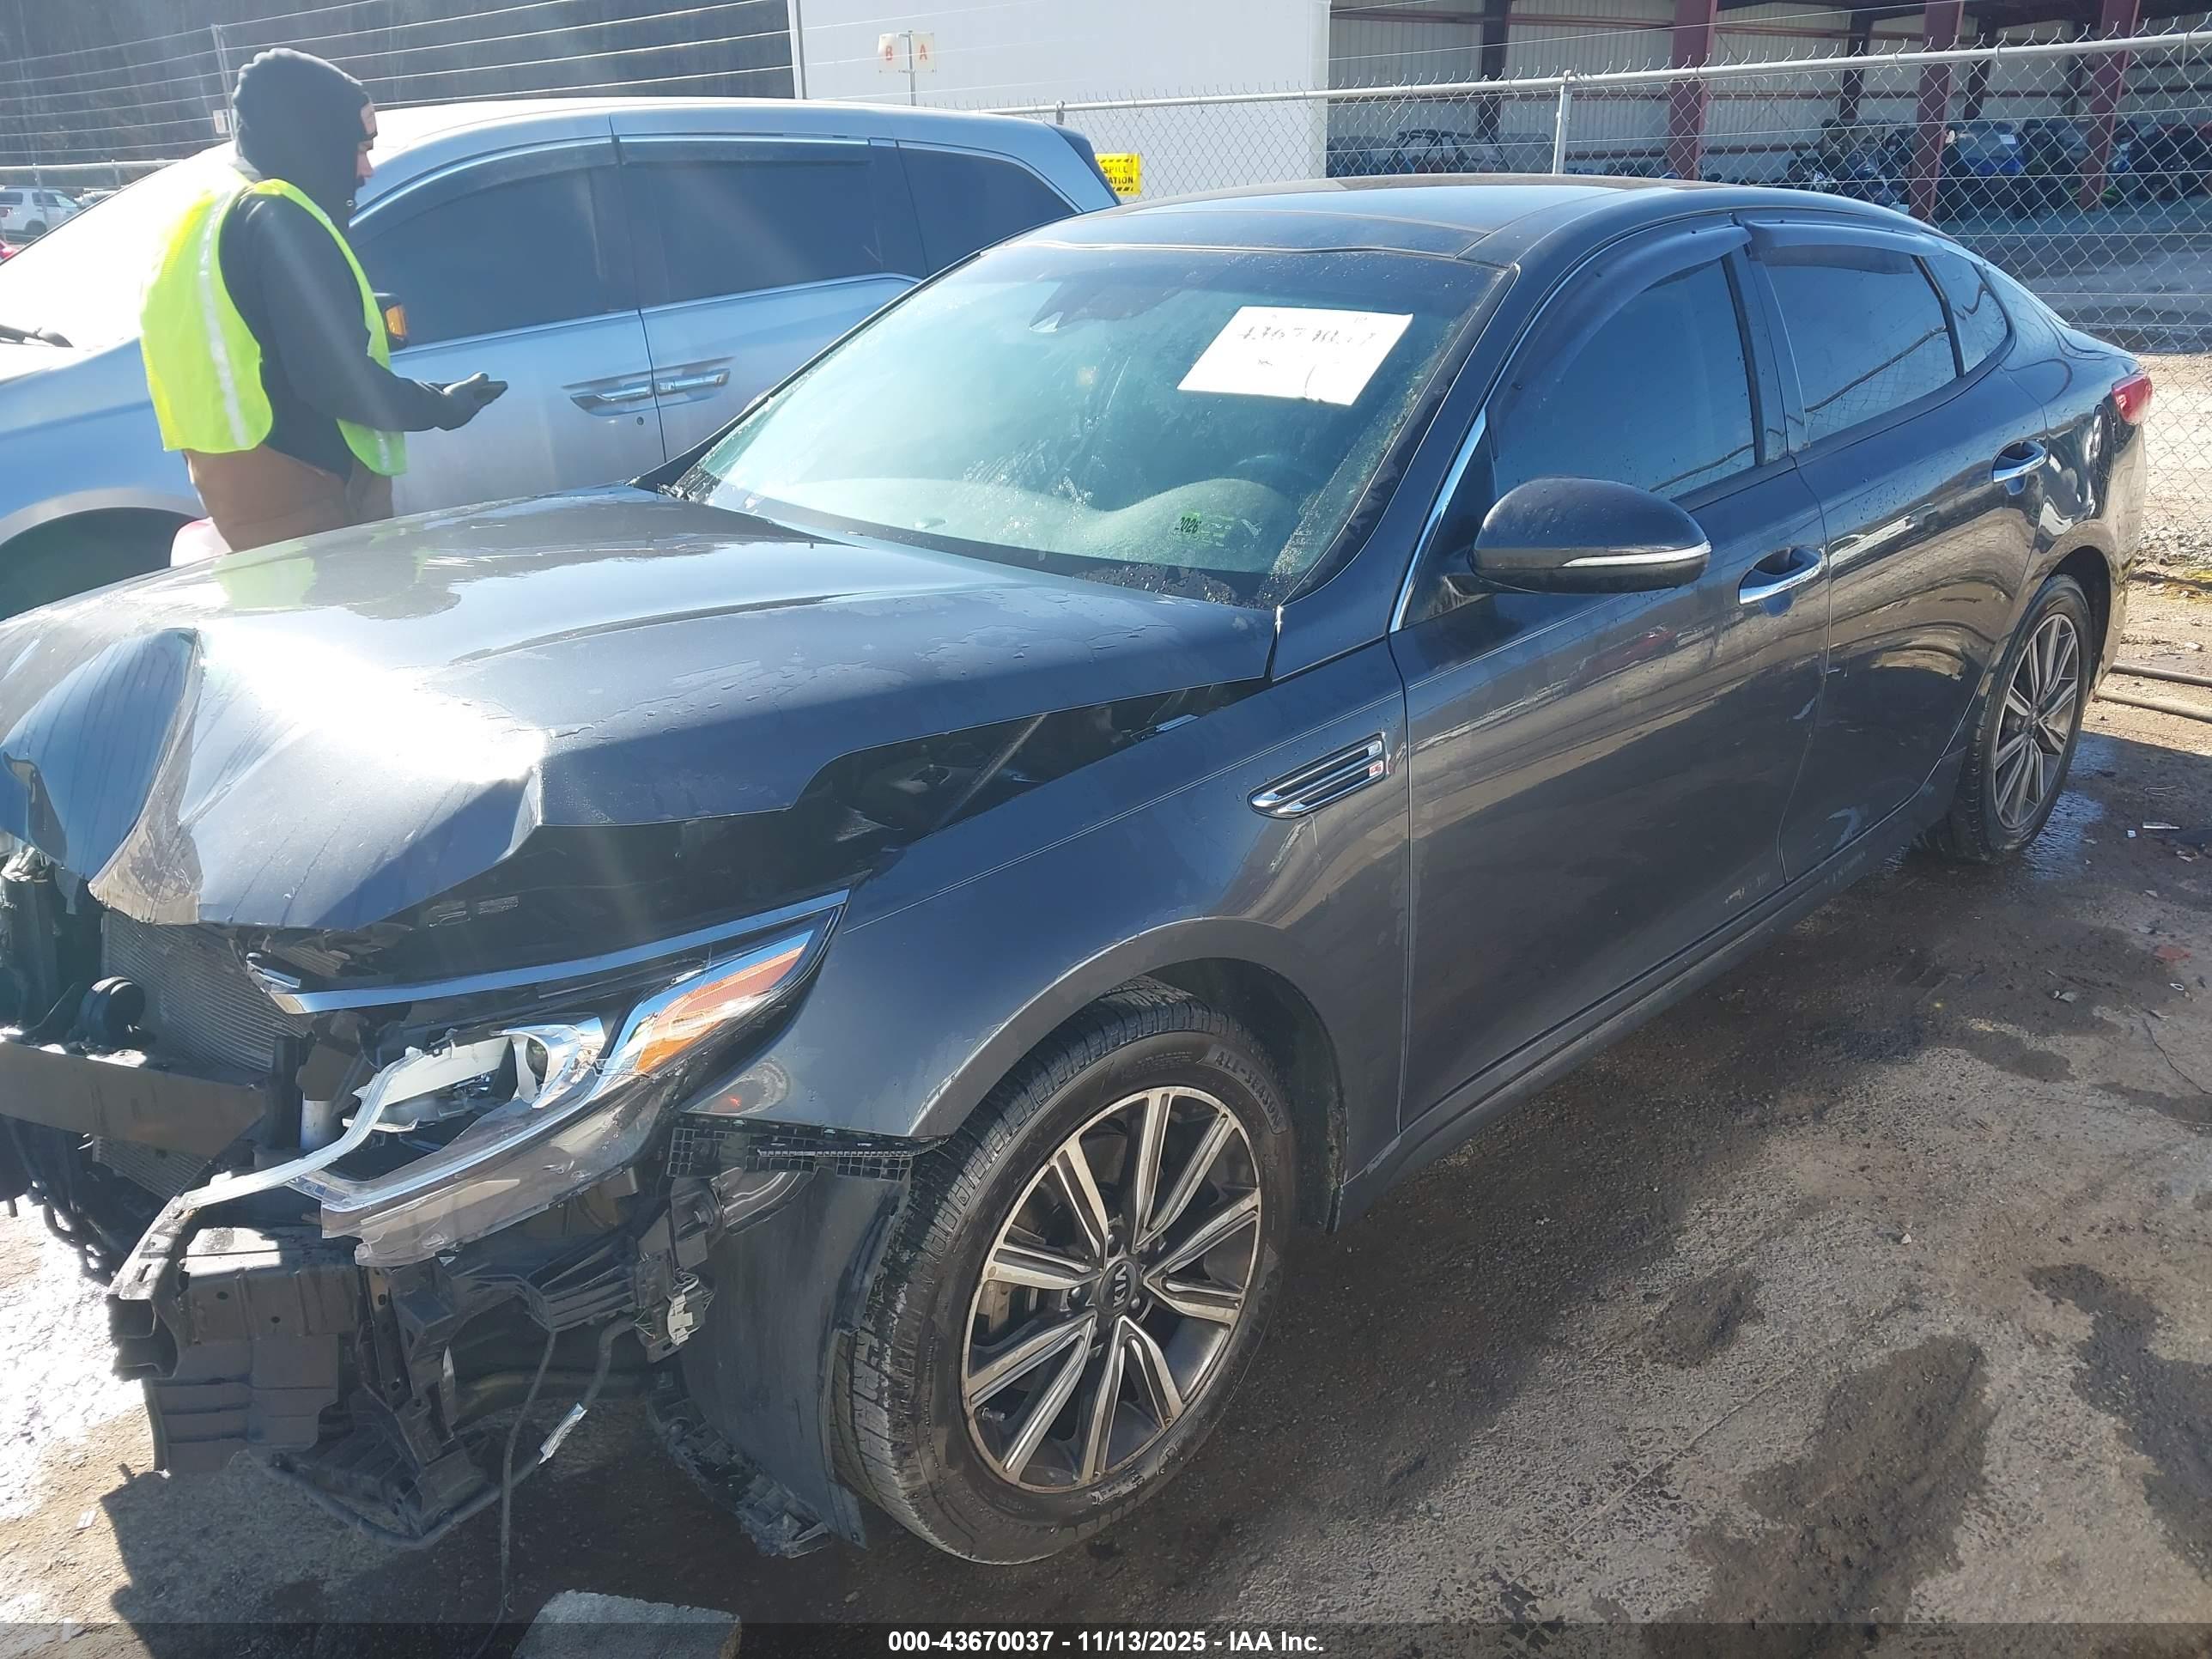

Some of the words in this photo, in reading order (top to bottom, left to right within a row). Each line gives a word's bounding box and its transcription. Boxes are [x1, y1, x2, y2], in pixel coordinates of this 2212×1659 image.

[885, 44, 893, 60] B
[920, 44, 927, 60] A
[1113, 1265, 1127, 1308] KIA
